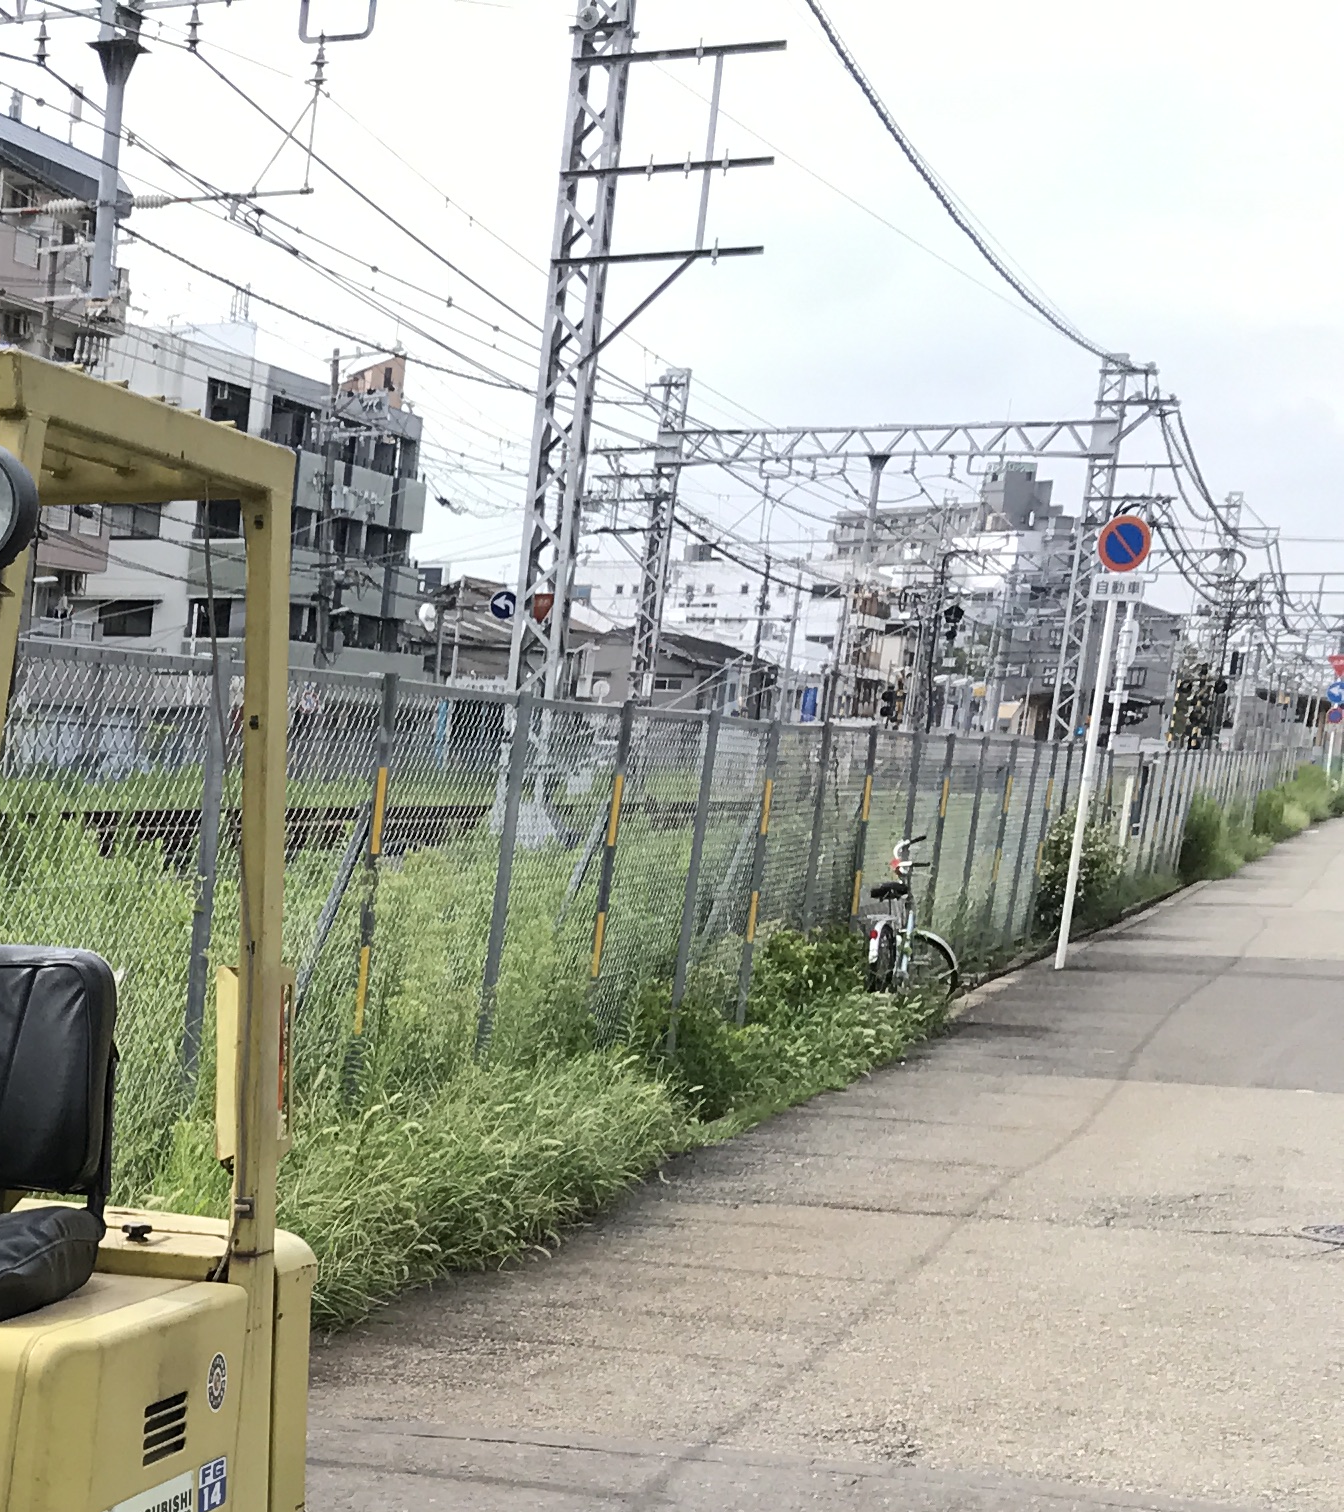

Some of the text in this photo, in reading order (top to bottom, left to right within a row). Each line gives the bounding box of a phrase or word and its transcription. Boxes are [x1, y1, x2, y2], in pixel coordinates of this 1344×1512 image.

[1095, 580, 1140, 595] 自動車
[201, 1459, 224, 1485] FG
[203, 1481, 222, 1511] 14
